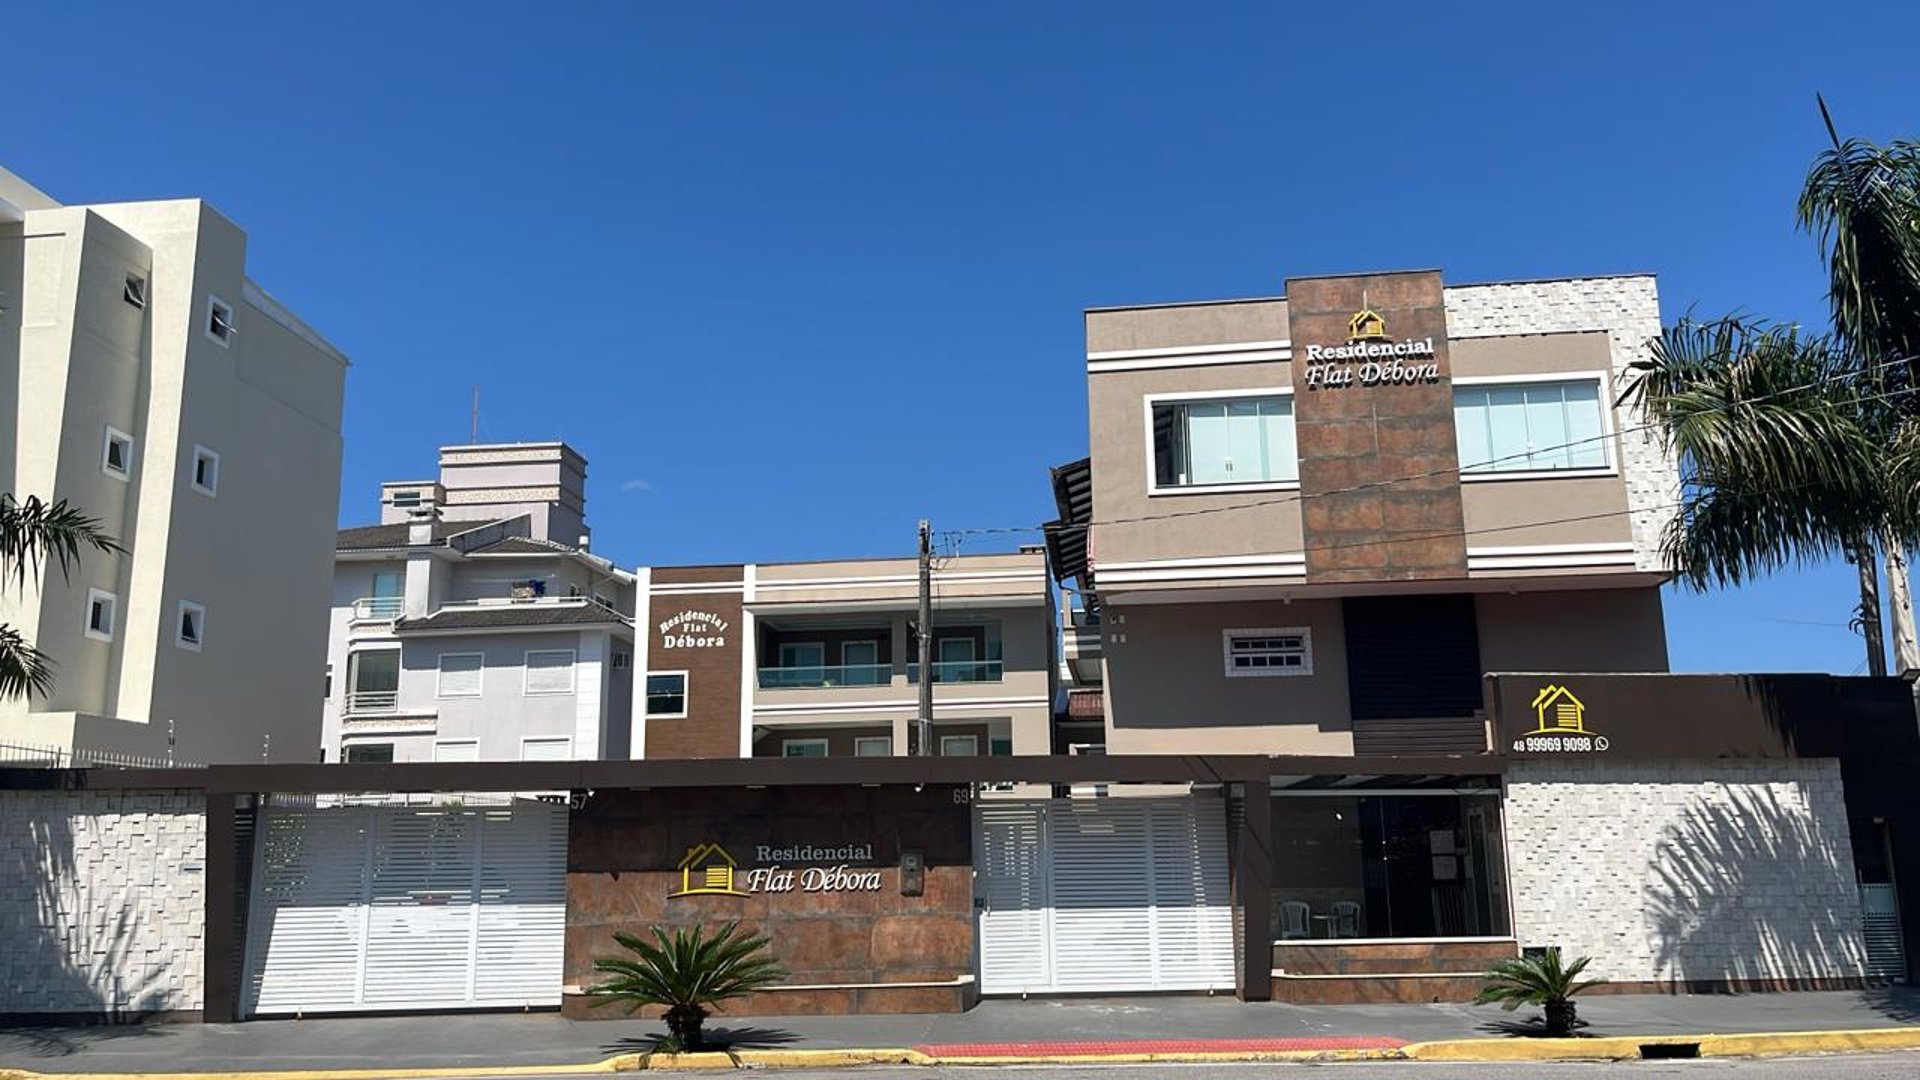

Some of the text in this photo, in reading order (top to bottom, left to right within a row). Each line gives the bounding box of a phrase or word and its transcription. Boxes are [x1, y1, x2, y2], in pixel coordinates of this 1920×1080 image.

[1306, 337, 1434, 361] Residencial
[1305, 358, 1439, 385] Flat Débora
[659, 610, 728, 634] Residencial
[683, 623, 707, 633] Flat
[664, 634, 725, 648] Débora
[1513, 737, 1591, 752] 48 99969 9098
[571, 794, 587, 810] 57
[953, 788, 969, 804] 69
[756, 844, 873, 862] Residencial
[747, 864, 881, 892] Flat Débora
